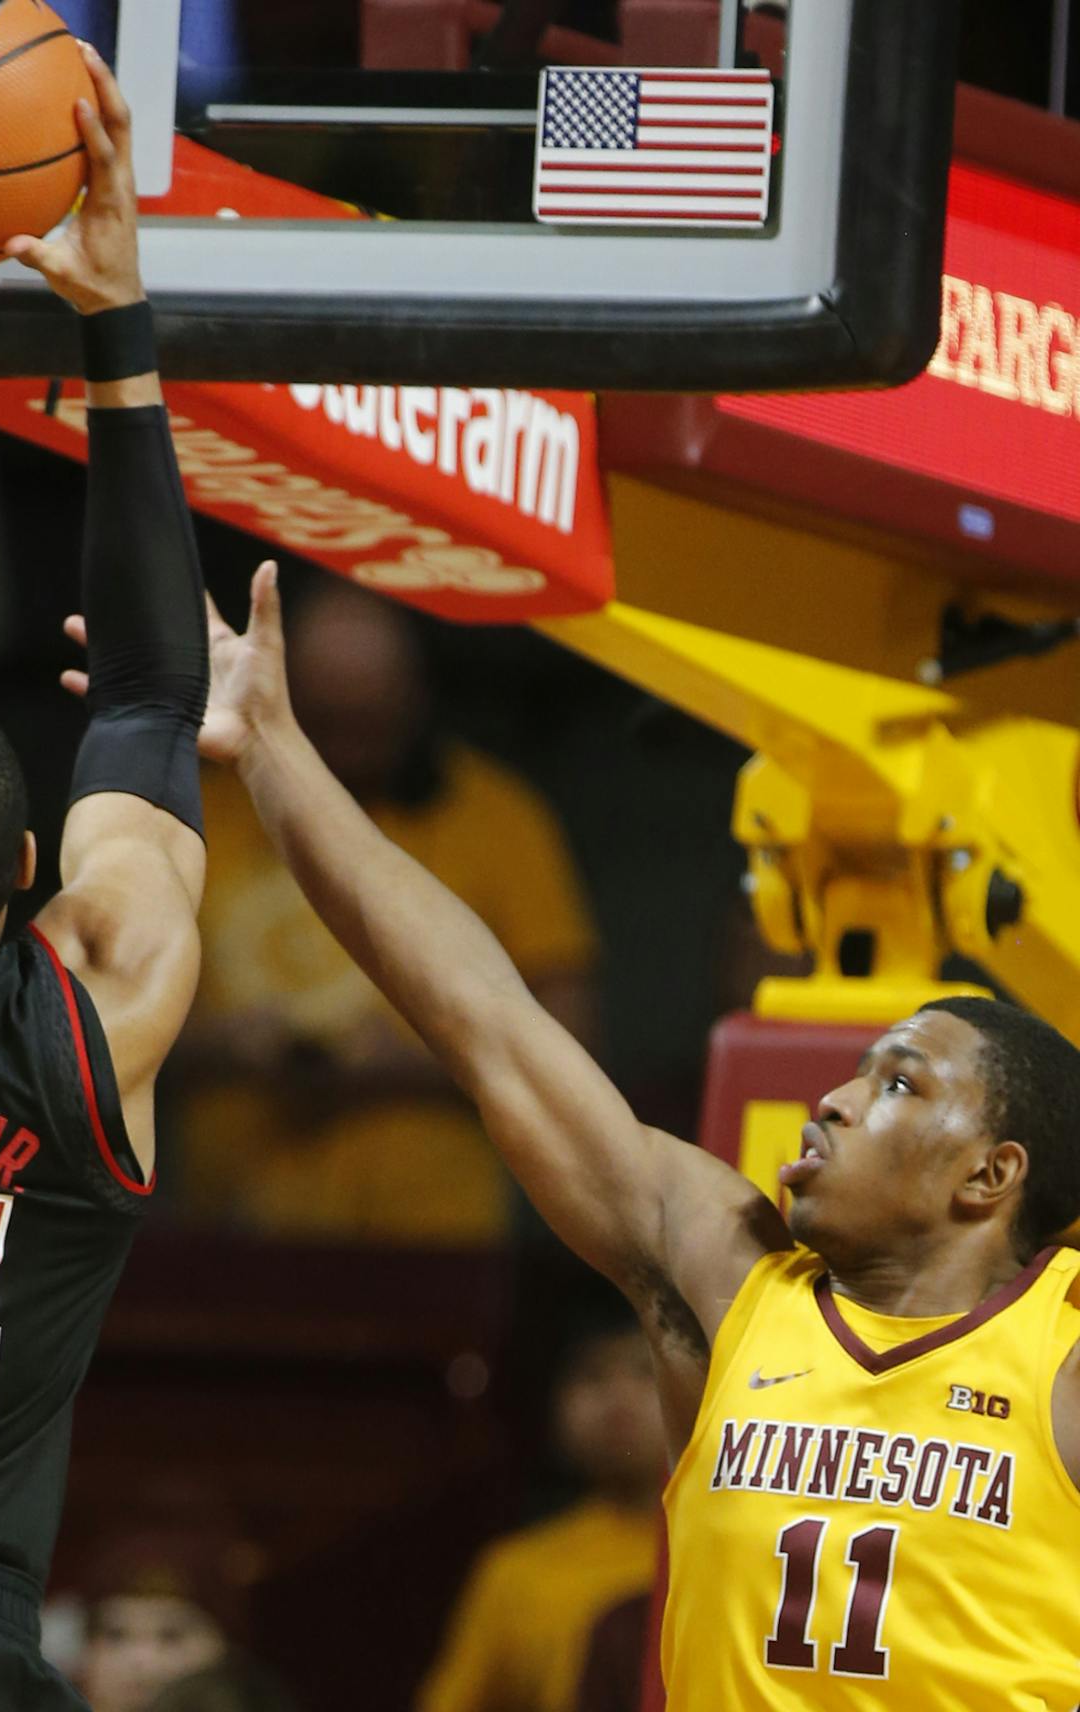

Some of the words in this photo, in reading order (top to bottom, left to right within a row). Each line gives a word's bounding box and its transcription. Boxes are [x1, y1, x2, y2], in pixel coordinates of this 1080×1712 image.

[927, 273, 1080, 423] FARG
[711, 1420, 1015, 1529] MINNESOTA
[765, 1516, 899, 1680] 11
